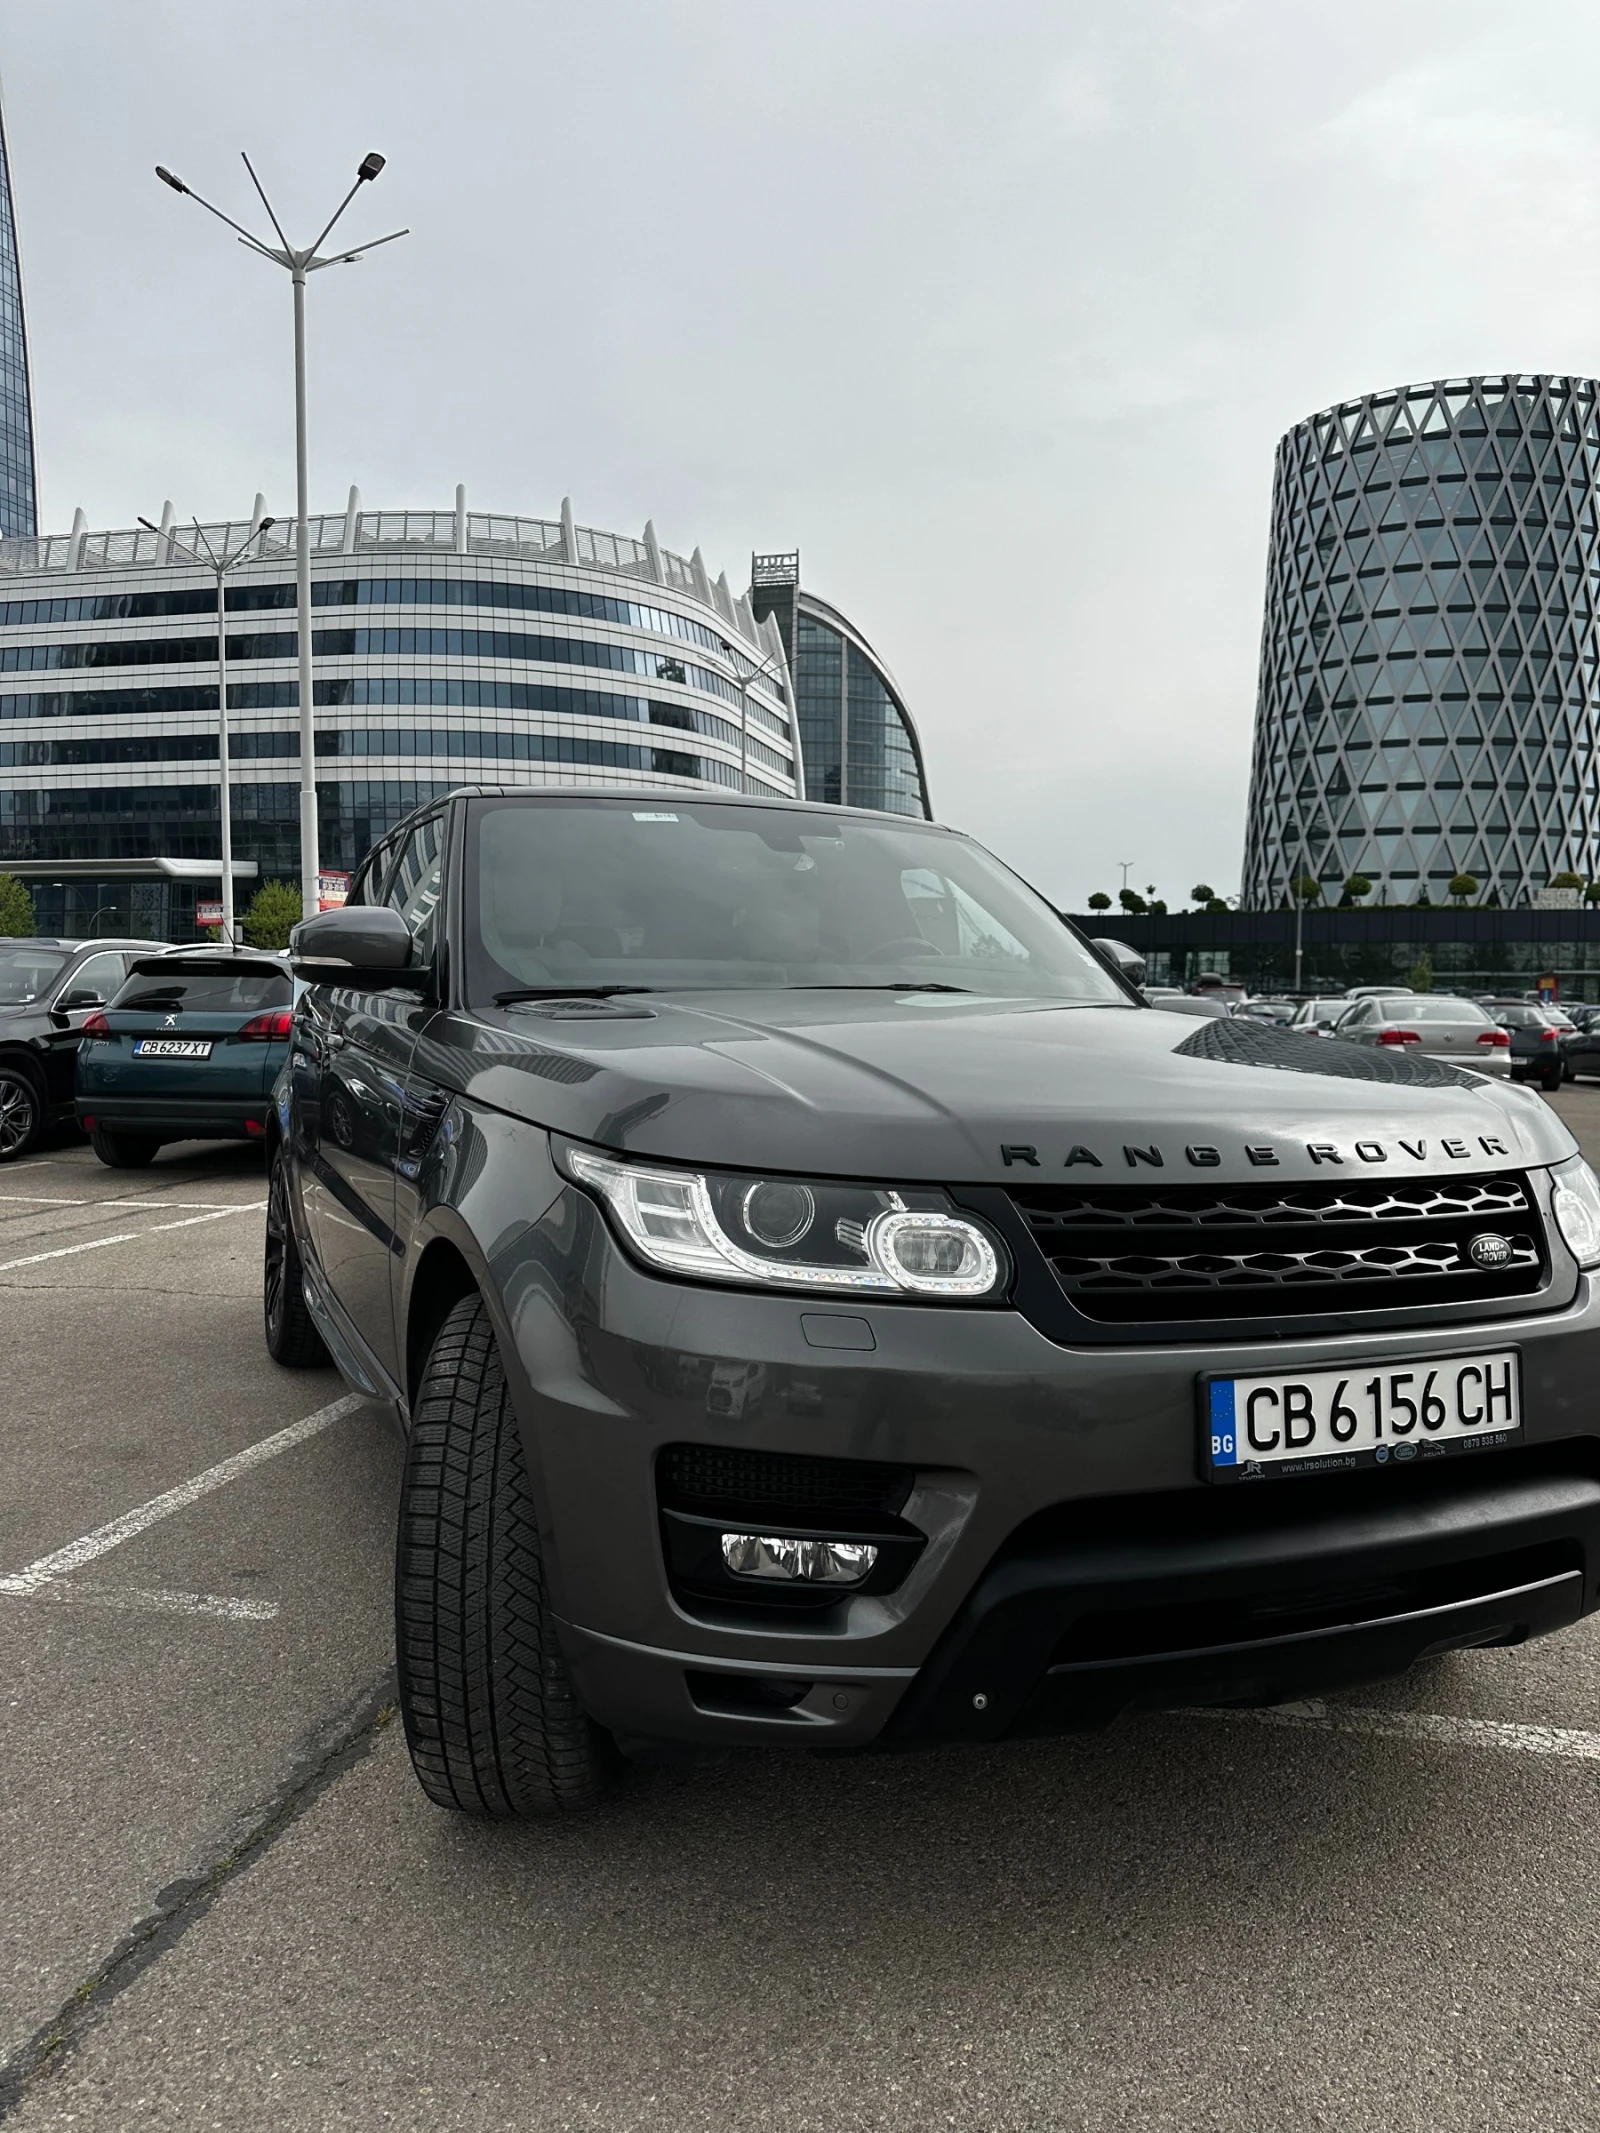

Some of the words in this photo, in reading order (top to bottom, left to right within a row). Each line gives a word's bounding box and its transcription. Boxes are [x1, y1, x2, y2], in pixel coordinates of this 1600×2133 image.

[142, 1041, 158, 1053] CB
[160, 1042, 190, 1054] 6237
[191, 1042, 209, 1054] XT
[1001, 1143, 1281, 1168] RANGE
[1306, 1135, 1510, 1165] ROVER
[1479, 1242, 1500, 1252] LAND
[1483, 1250, 1507, 1261] ROVER
[1246, 1383, 1316, 1451] CB
[1329, 1370, 1446, 1443] 6156
[1456, 1361, 1512, 1426] CH
[1211, 1435, 1233, 1455] BG
[1421, 1450, 1446, 1458] AGUAR
[1281, 1456, 1356, 1473] www.lrsolution.bg
